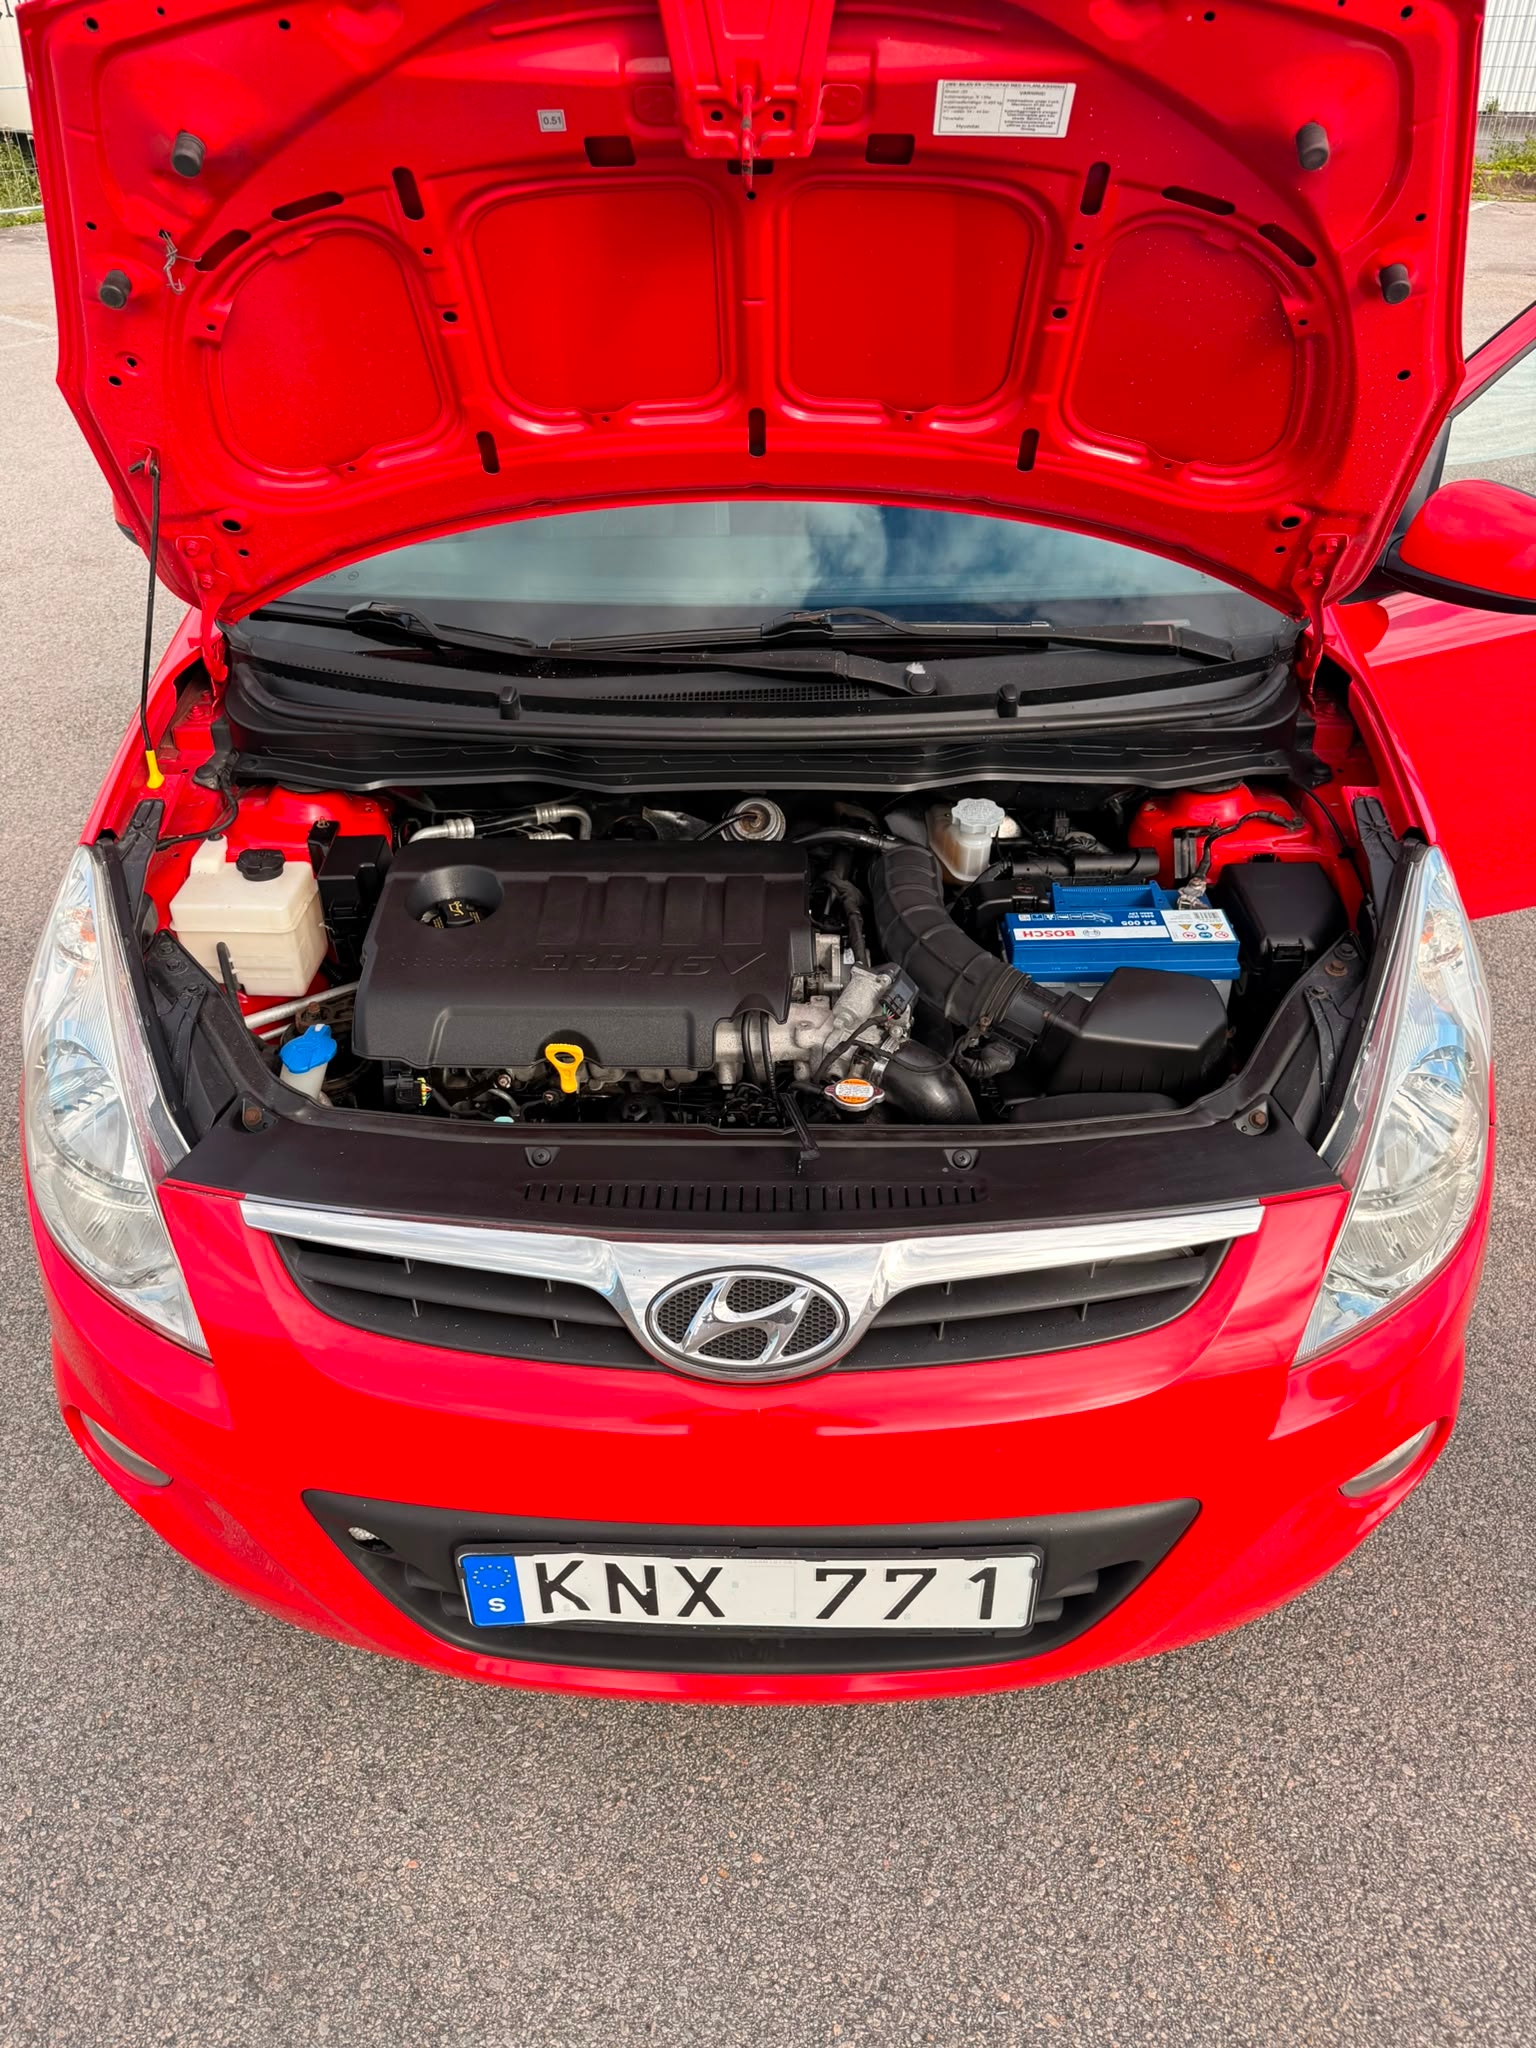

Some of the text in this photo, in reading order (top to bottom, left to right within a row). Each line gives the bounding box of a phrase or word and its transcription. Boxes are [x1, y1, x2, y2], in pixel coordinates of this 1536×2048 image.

[543, 116, 562, 126] 0.51
[1022, 929, 1076, 938] BOSCH
[535, 1559, 998, 1621] KNX 771
[488, 1597, 506, 1612] S
